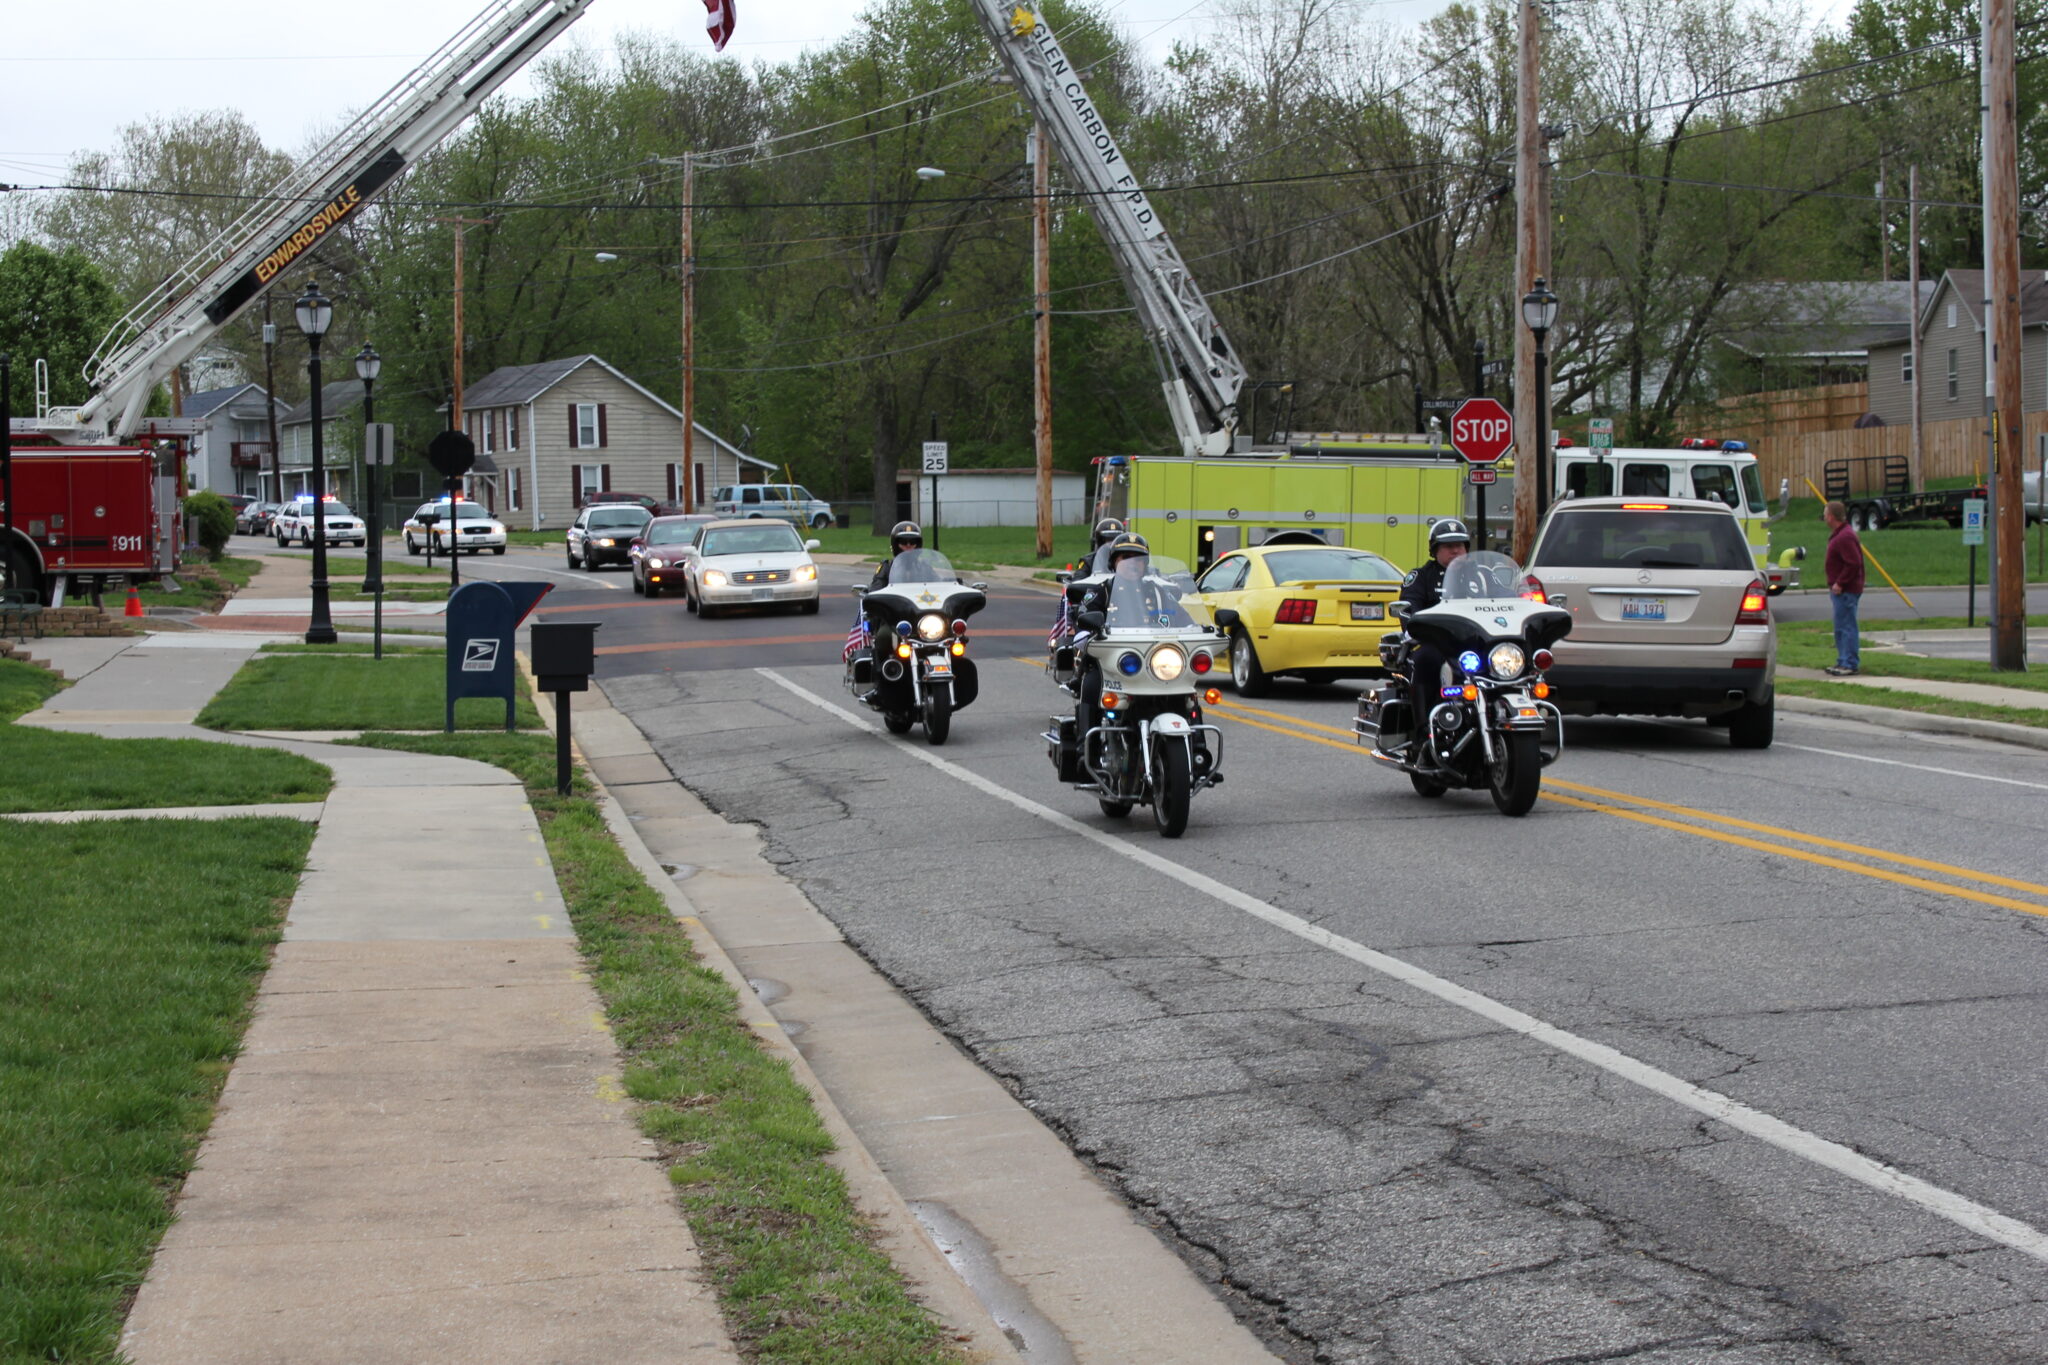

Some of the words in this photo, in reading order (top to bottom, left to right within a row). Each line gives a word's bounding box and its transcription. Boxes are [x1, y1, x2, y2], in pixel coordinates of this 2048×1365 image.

[1031, 23, 1069, 77] GLEN
[1065, 83, 1119, 165] CARBON
[255, 184, 362, 283] EDWARDSVILLE
[1456, 419, 1508, 442] STOP
[1592, 433, 1610, 441] BUS
[1592, 440, 1610, 448] STOP
[925, 458, 945, 470] 25
[1472, 471, 1481, 480] ALL
[1483, 471, 1494, 480] WAY
[118, 535, 142, 551] 911
[1474, 605, 1515, 613] POLICE
